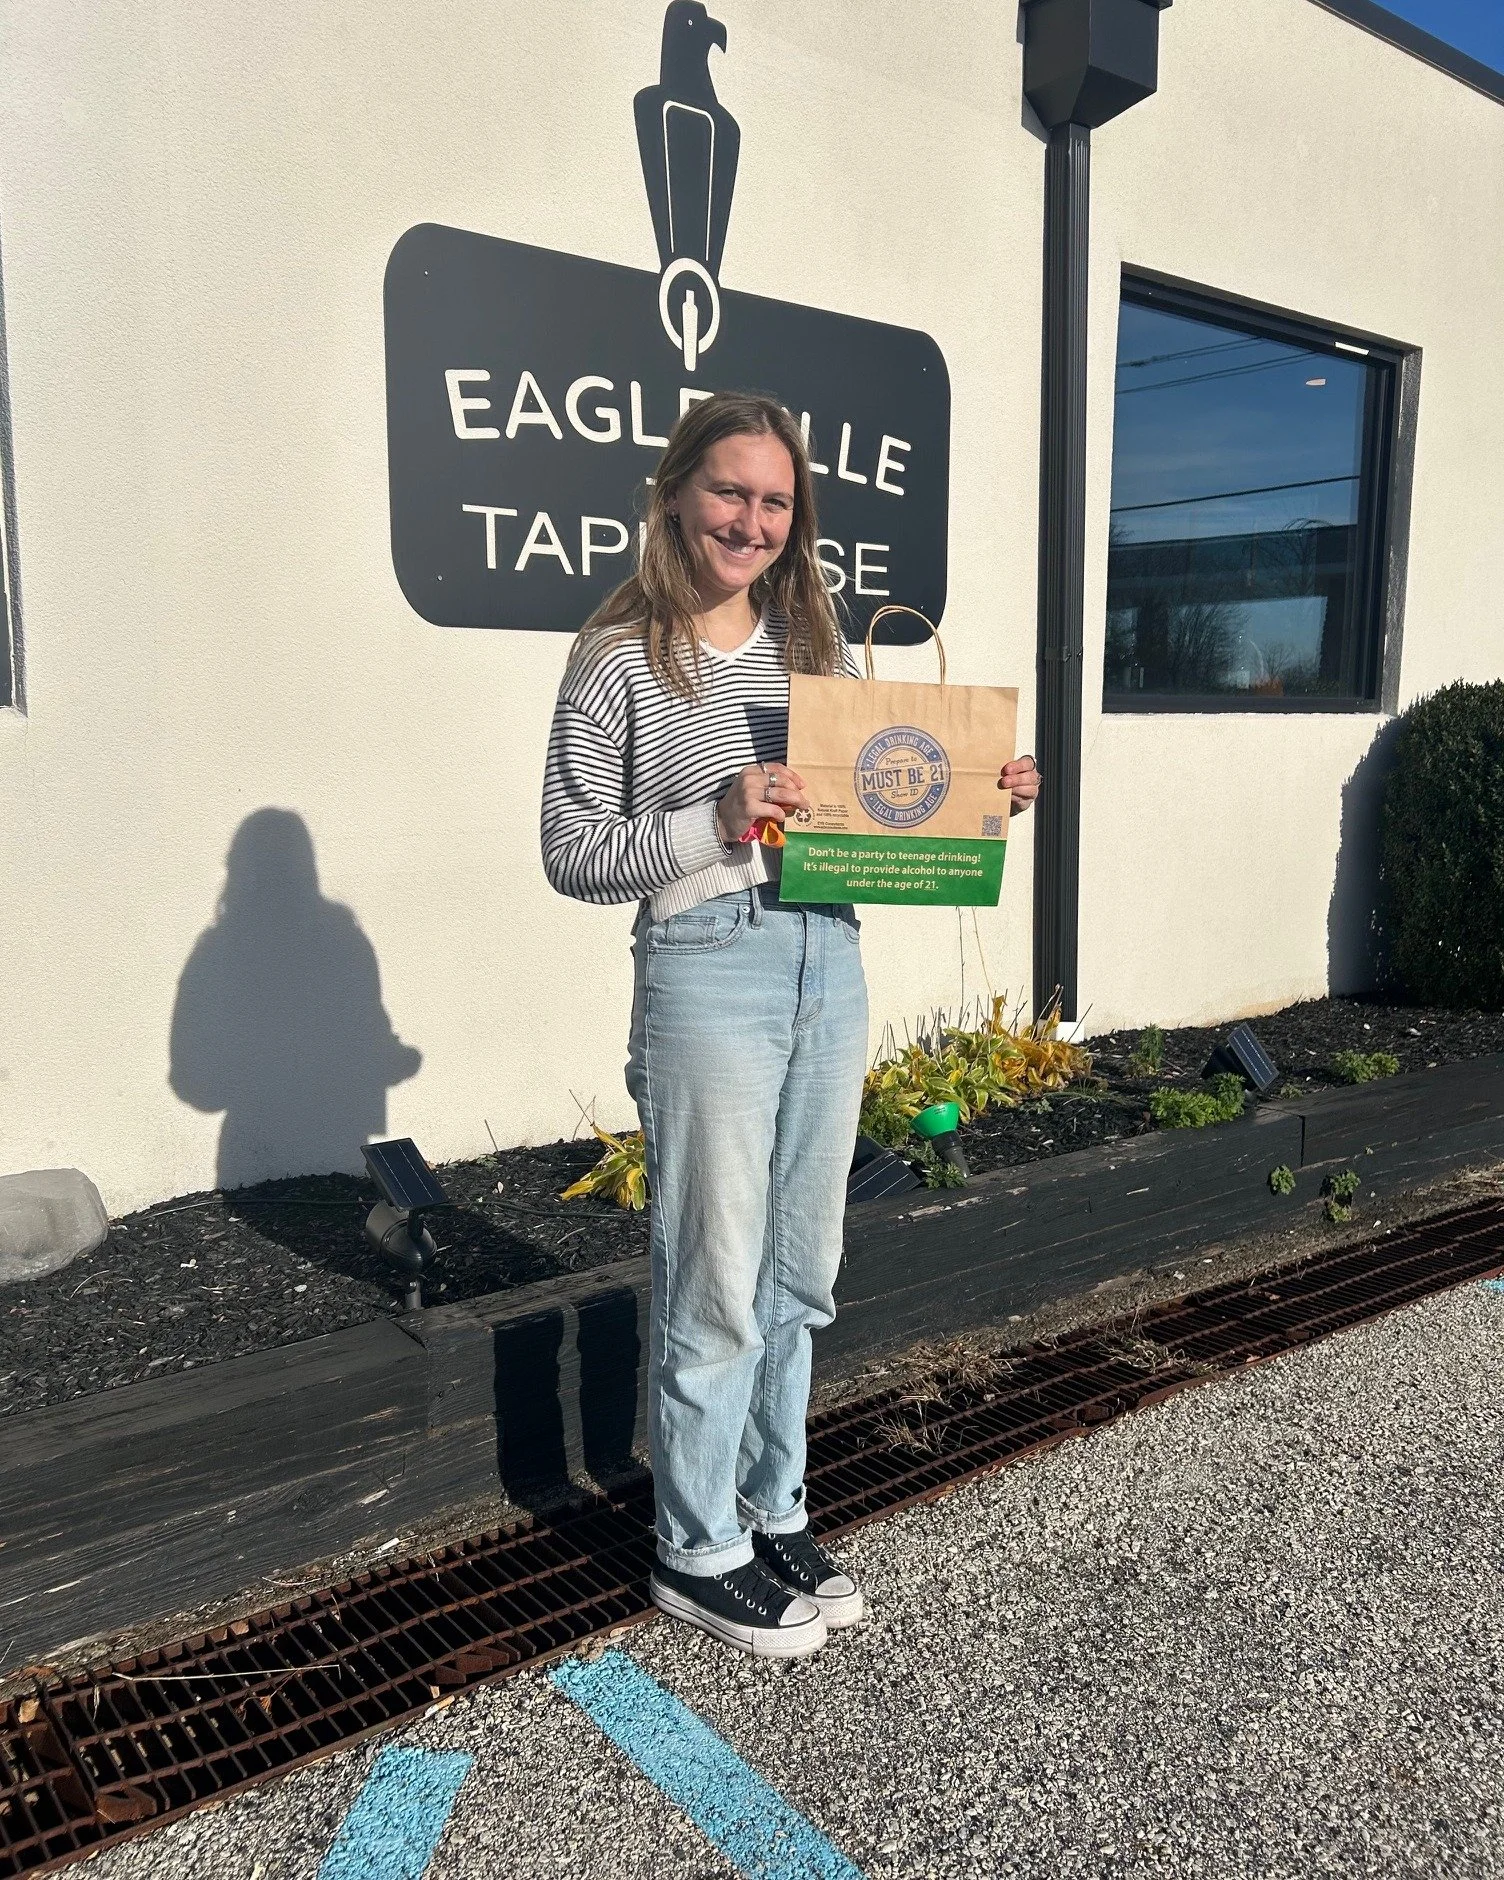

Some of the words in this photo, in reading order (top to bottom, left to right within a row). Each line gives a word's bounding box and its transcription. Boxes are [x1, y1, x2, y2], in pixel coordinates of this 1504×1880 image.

[445, 369, 911, 496] EAGLLLE
[462, 504, 891, 597] TAPSE
[866, 742, 886, 764] LEGAL
[885, 734, 919, 747] DRINKING
[920, 741, 933, 756] AGE
[886, 758, 909, 766] Prepare
[862, 769, 902, 791] MUST
[908, 767, 925, 784] BE
[930, 764, 944, 782] 21
[891, 790, 908, 799] Show
[872, 801, 892, 819] LEGAL
[895, 806, 926, 820] DRINKING
[924, 793, 938, 808] AGE
[808, 847, 835, 858] Don't
[836, 849, 849, 858] be
[858, 851, 883, 861] party
[886, 852, 896, 860] to
[898, 852, 936, 862] teenage
[938, 853, 981, 864] drinking!
[804, 862, 817, 871] It's
[819, 862, 849, 874] illegal
[851, 864, 861, 873] to
[863, 864, 900, 876] provide
[902, 864, 935, 875] alcohol
[937, 867, 946, 876] to
[948, 868, 983, 878] anyone
[846, 878, 875, 888] under
[877, 879, 892, 889] the
[894, 881, 912, 891] age
[914, 880, 924, 889] of
[925, 880, 939, 890] 21.
